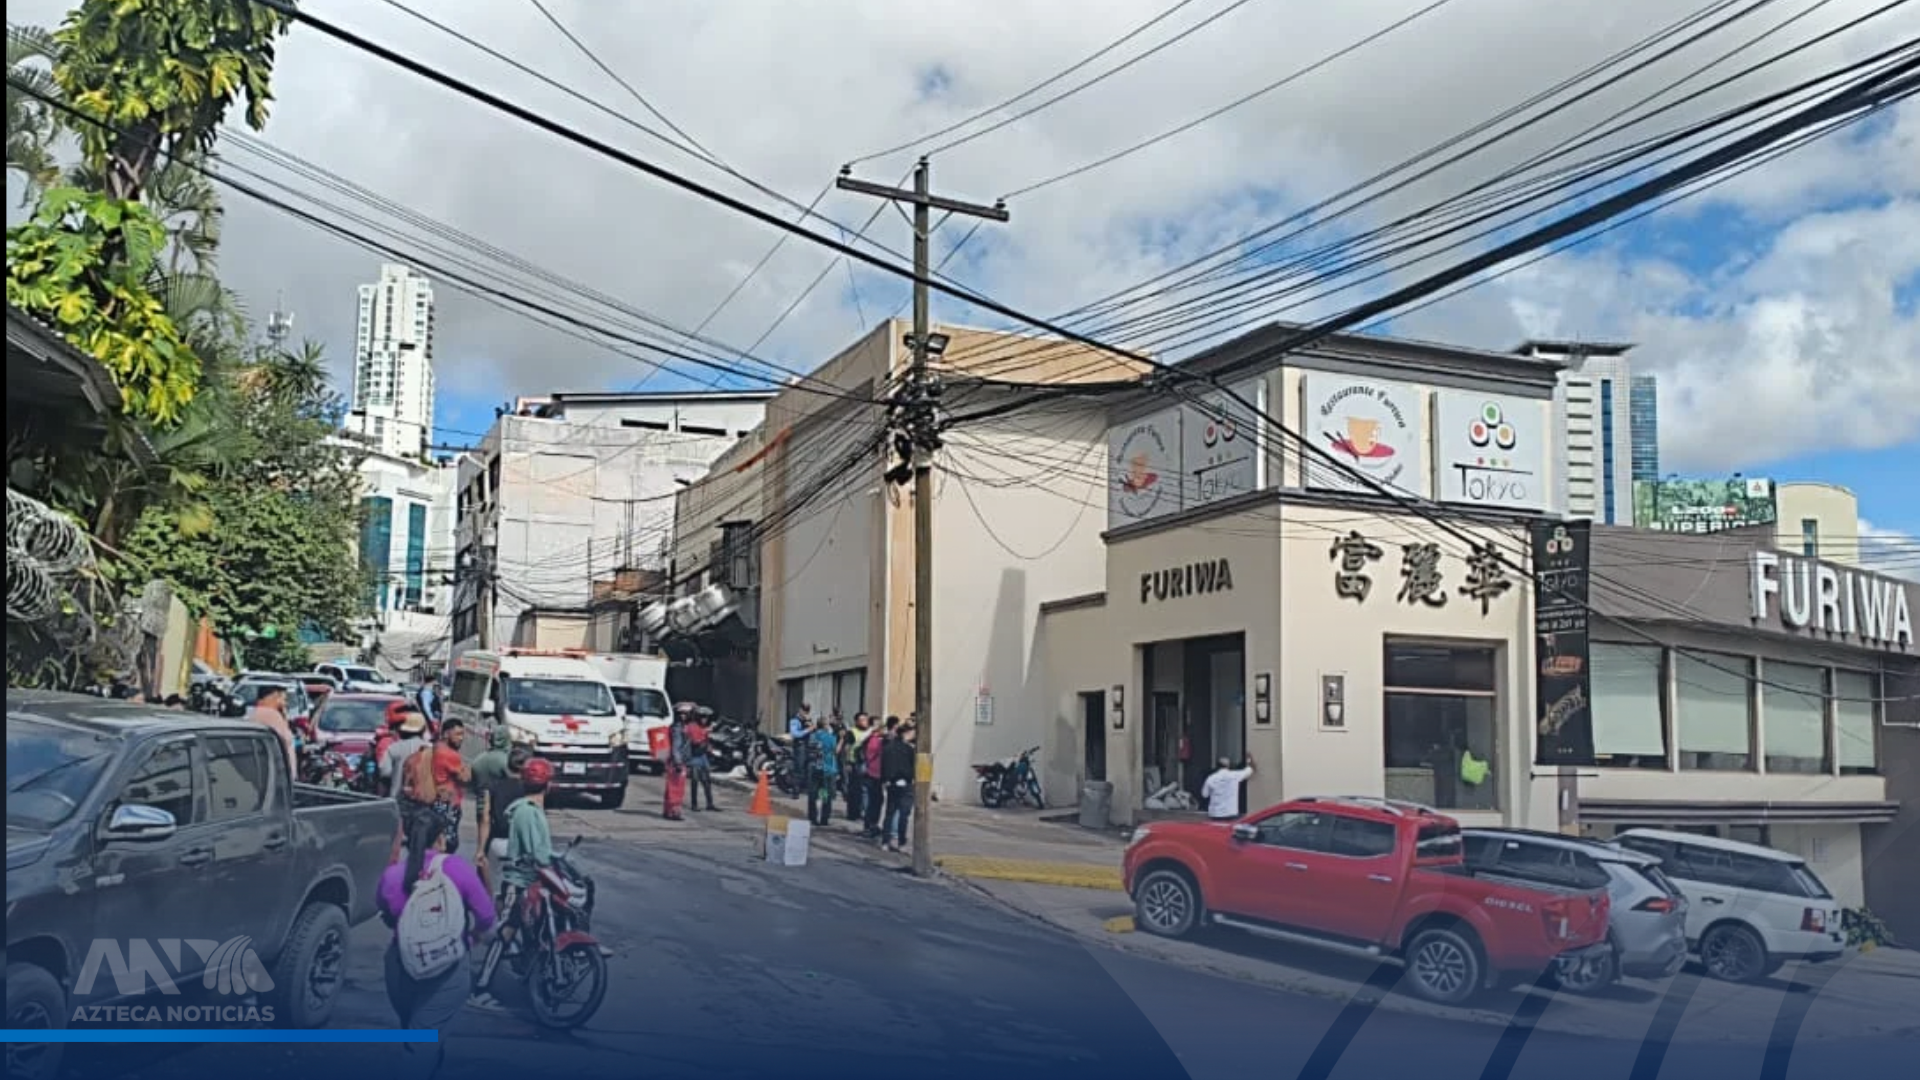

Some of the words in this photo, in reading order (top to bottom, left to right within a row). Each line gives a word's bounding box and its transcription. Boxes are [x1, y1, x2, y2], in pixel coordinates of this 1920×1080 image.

[1453, 462, 1533, 500] Tokyo
[1140, 558, 1233, 604] FURIWA
[1757, 551, 1913, 645] FURIWA
